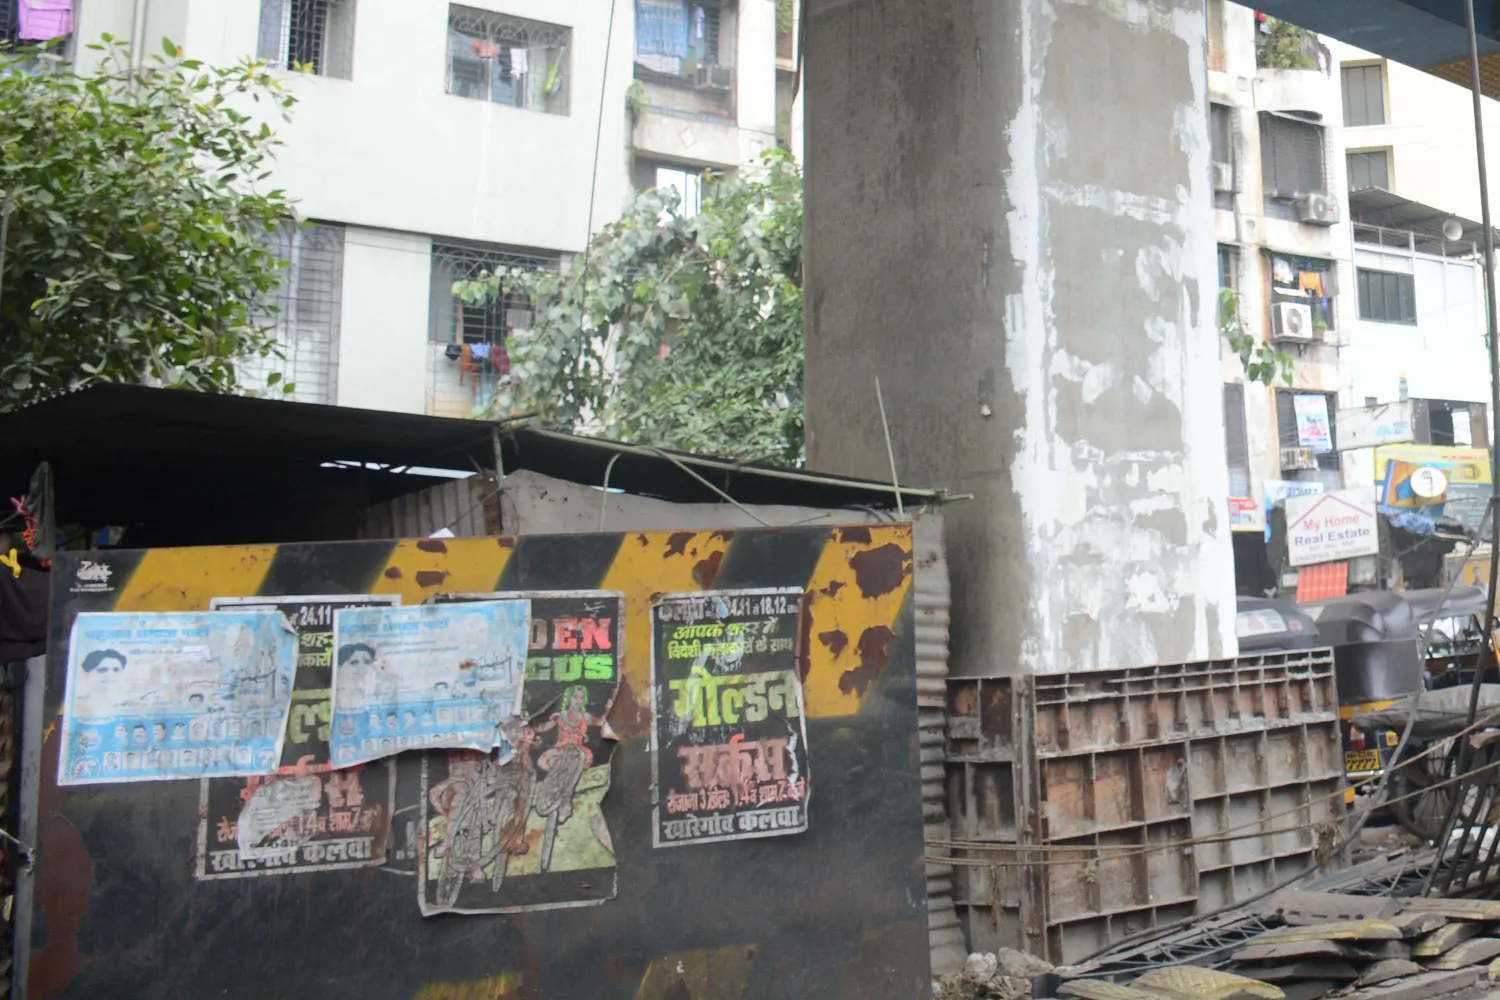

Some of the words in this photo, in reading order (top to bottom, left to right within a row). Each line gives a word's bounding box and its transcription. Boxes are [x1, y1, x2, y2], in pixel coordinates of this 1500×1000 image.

[1303, 519, 1320, 532] My
[1324, 514, 1361, 528] Home
[1294, 533, 1324, 547] Real
[1327, 527, 1371, 542] Estate
[300, 605, 332, 626] 24.11
[669, 666, 800, 728] गोल्डन
[677, 733, 788, 789] सर्कस
